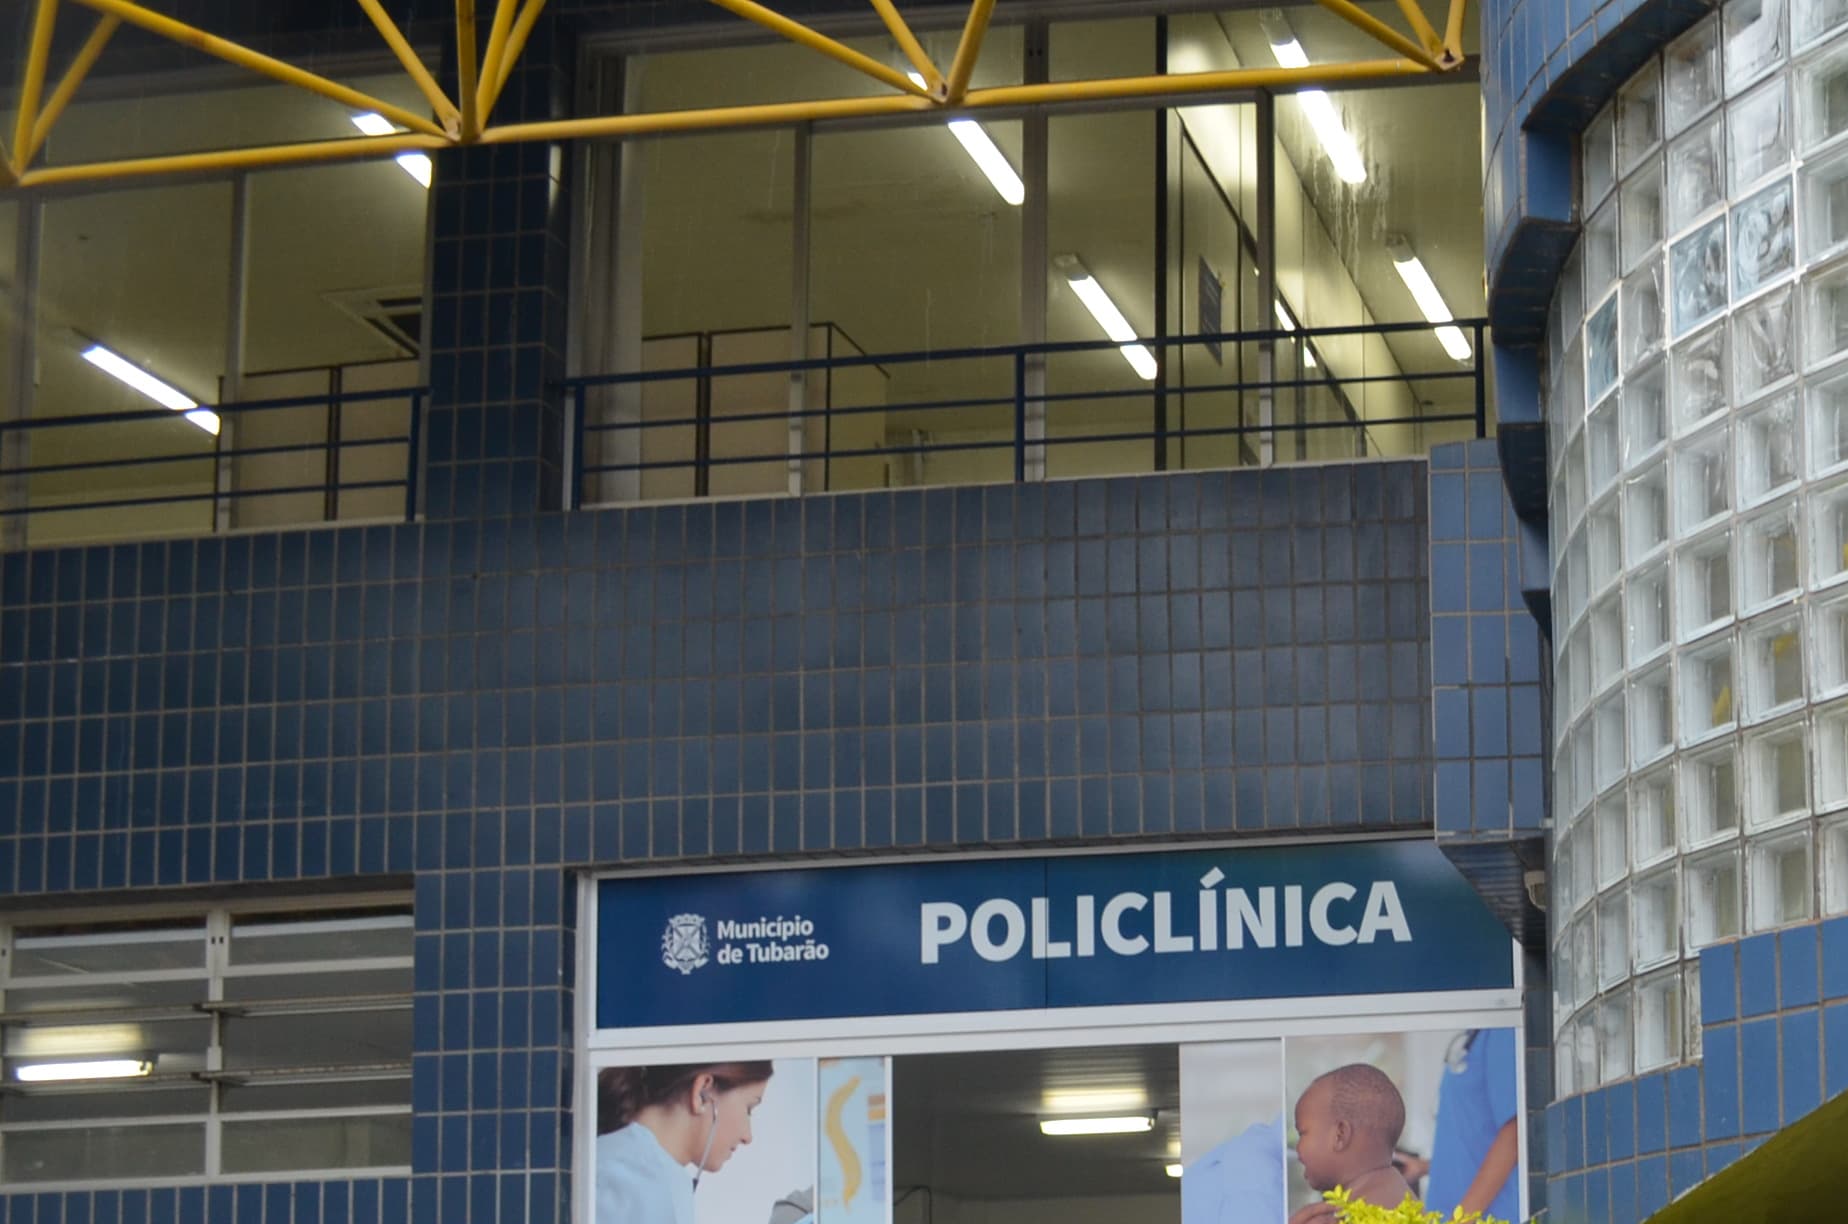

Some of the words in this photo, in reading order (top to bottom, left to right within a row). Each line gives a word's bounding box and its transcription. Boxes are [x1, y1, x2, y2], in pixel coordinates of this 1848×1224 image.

[717, 915, 815, 942] Município
[920, 867, 1413, 965] POLICLÍNICA
[717, 943, 744, 965] de
[745, 938, 830, 963] Tubarão
